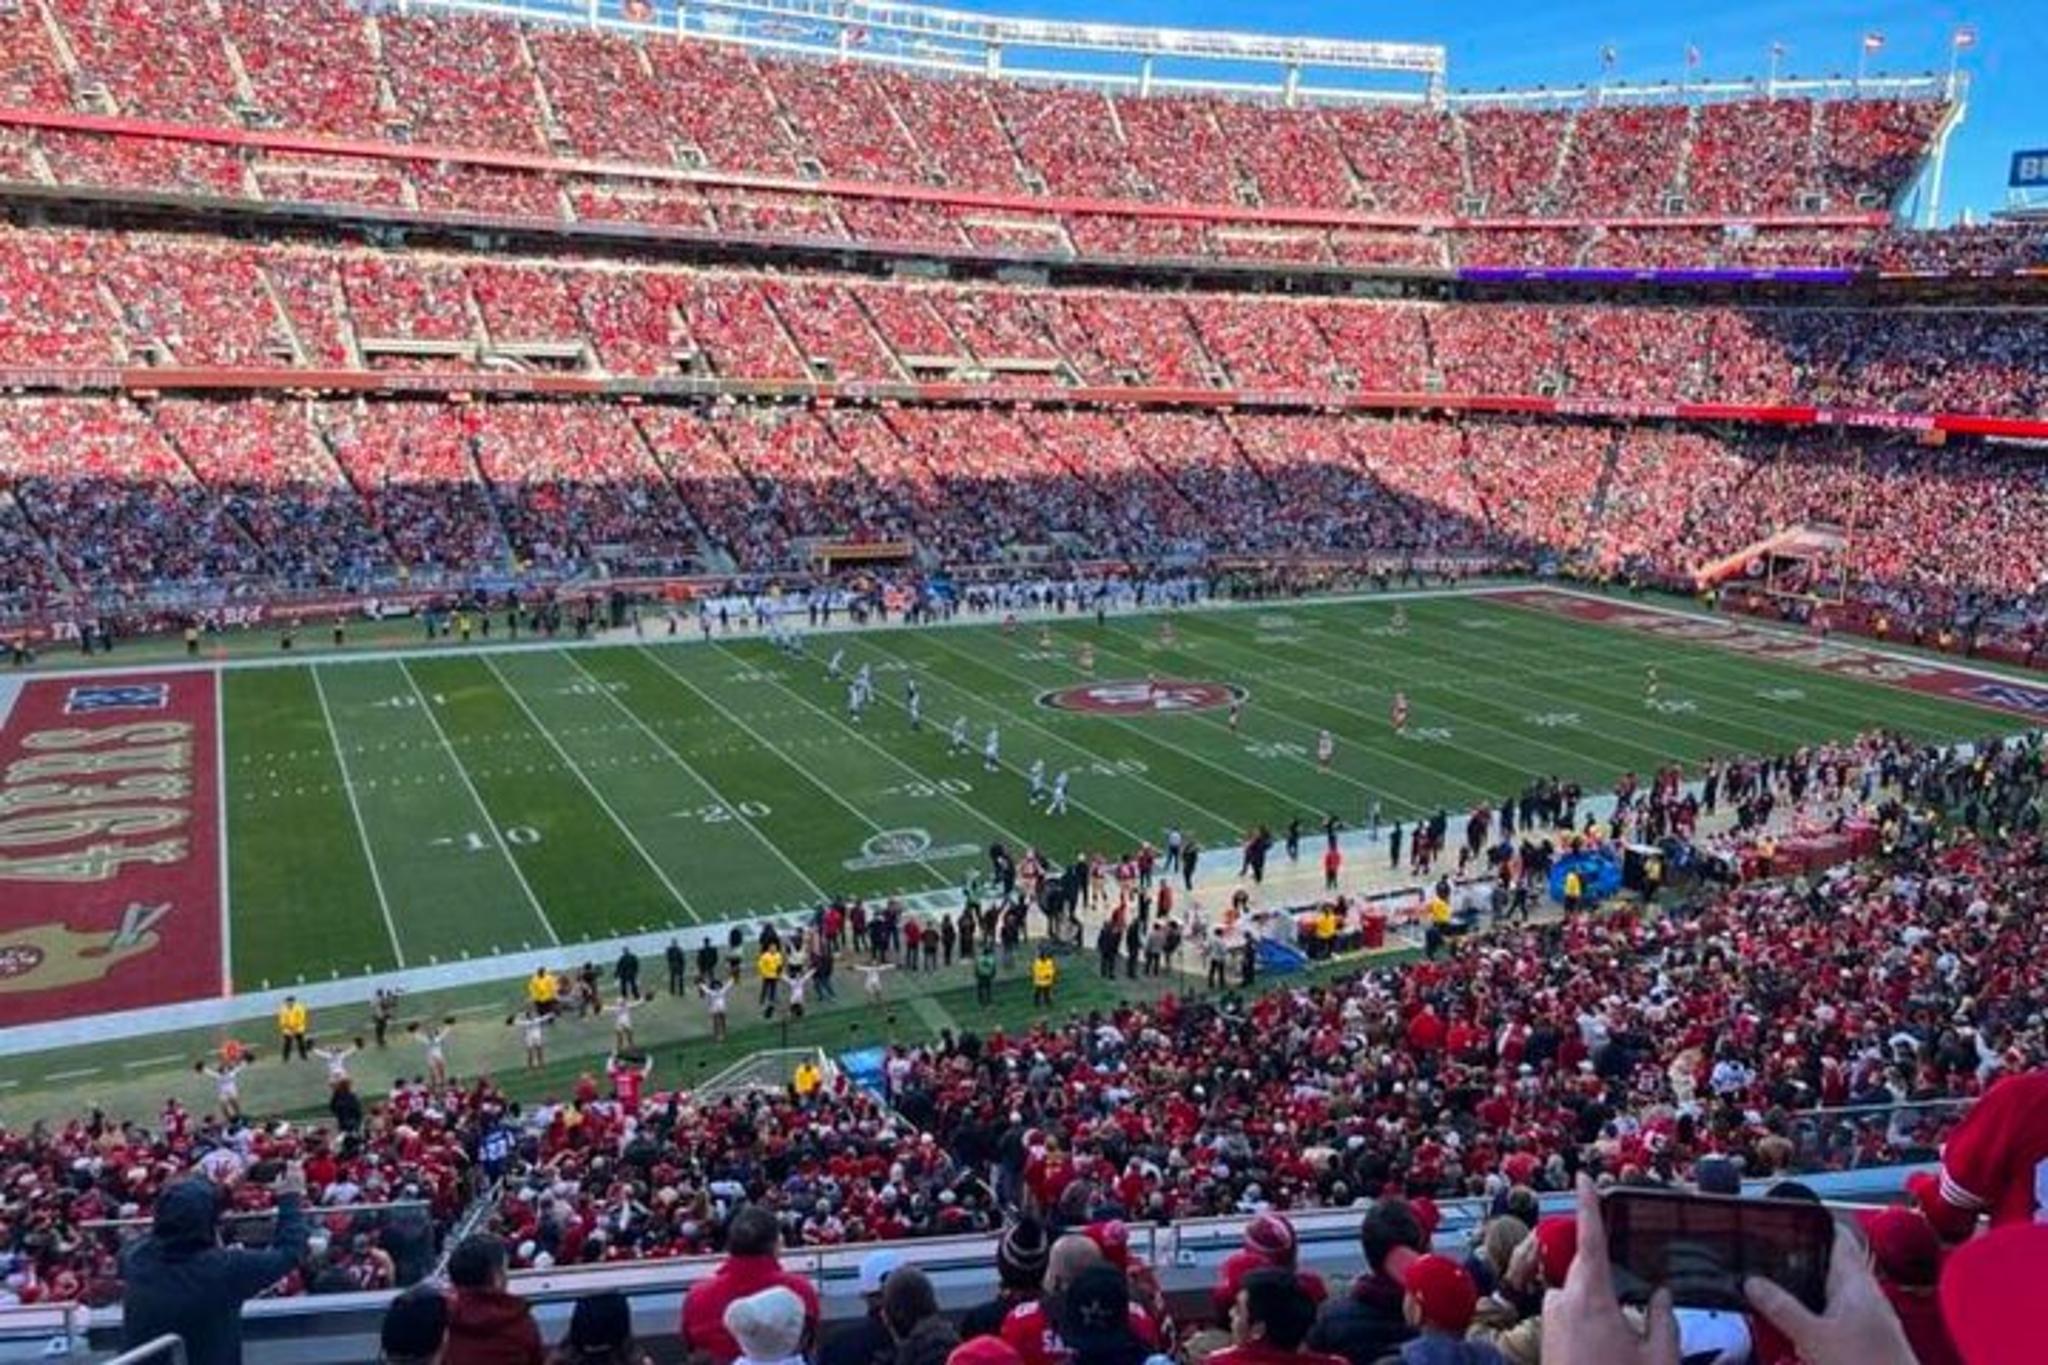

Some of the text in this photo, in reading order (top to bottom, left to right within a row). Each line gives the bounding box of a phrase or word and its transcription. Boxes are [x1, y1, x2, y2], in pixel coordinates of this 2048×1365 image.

[0, 721, 195, 883] 49ERS
[696, 801, 772, 823] 20
[461, 825, 542, 850] 10
